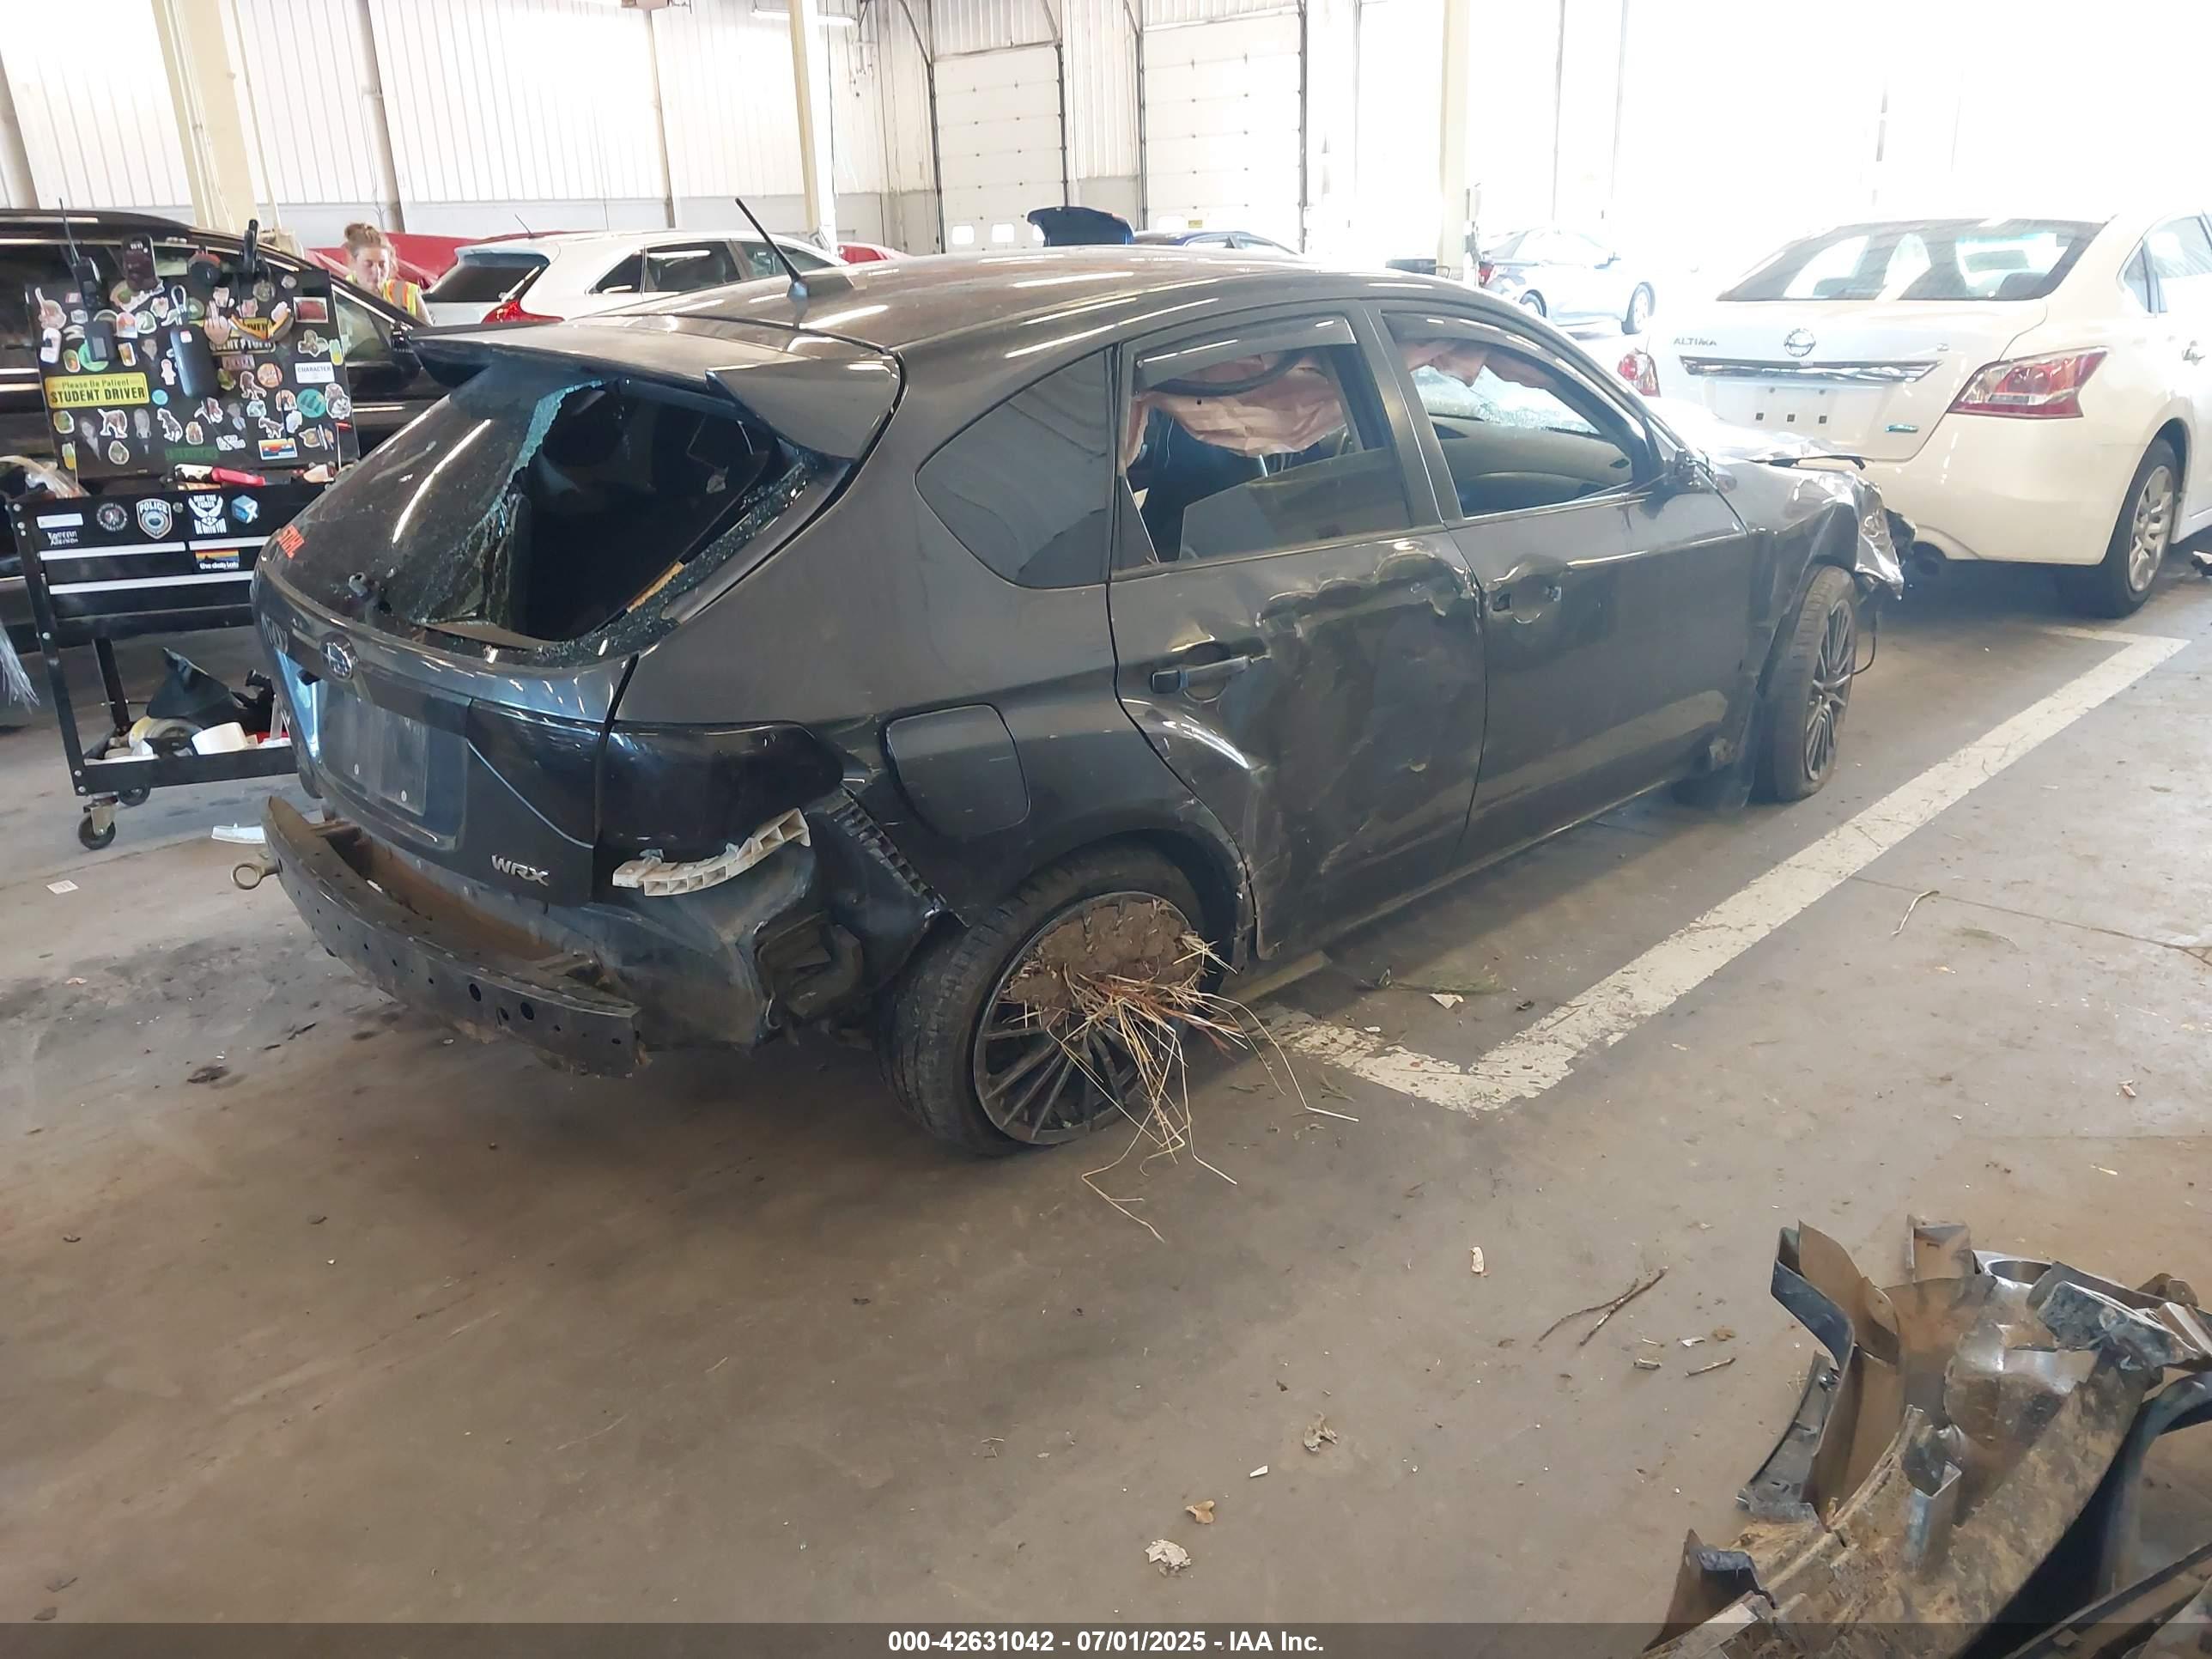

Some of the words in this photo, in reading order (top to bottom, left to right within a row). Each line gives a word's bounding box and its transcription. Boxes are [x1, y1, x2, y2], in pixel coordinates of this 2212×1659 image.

[1674, 337, 1717, 346] ALTIMA
[62, 380, 88, 390] Please
[89, 380, 100, 389] Be
[102, 378, 130, 387] Patient
[50, 389, 100, 404] STUDENT
[105, 387, 146, 400] DRIVER
[138, 501, 168, 514] POLICE
[491, 854, 549, 886] WRX
